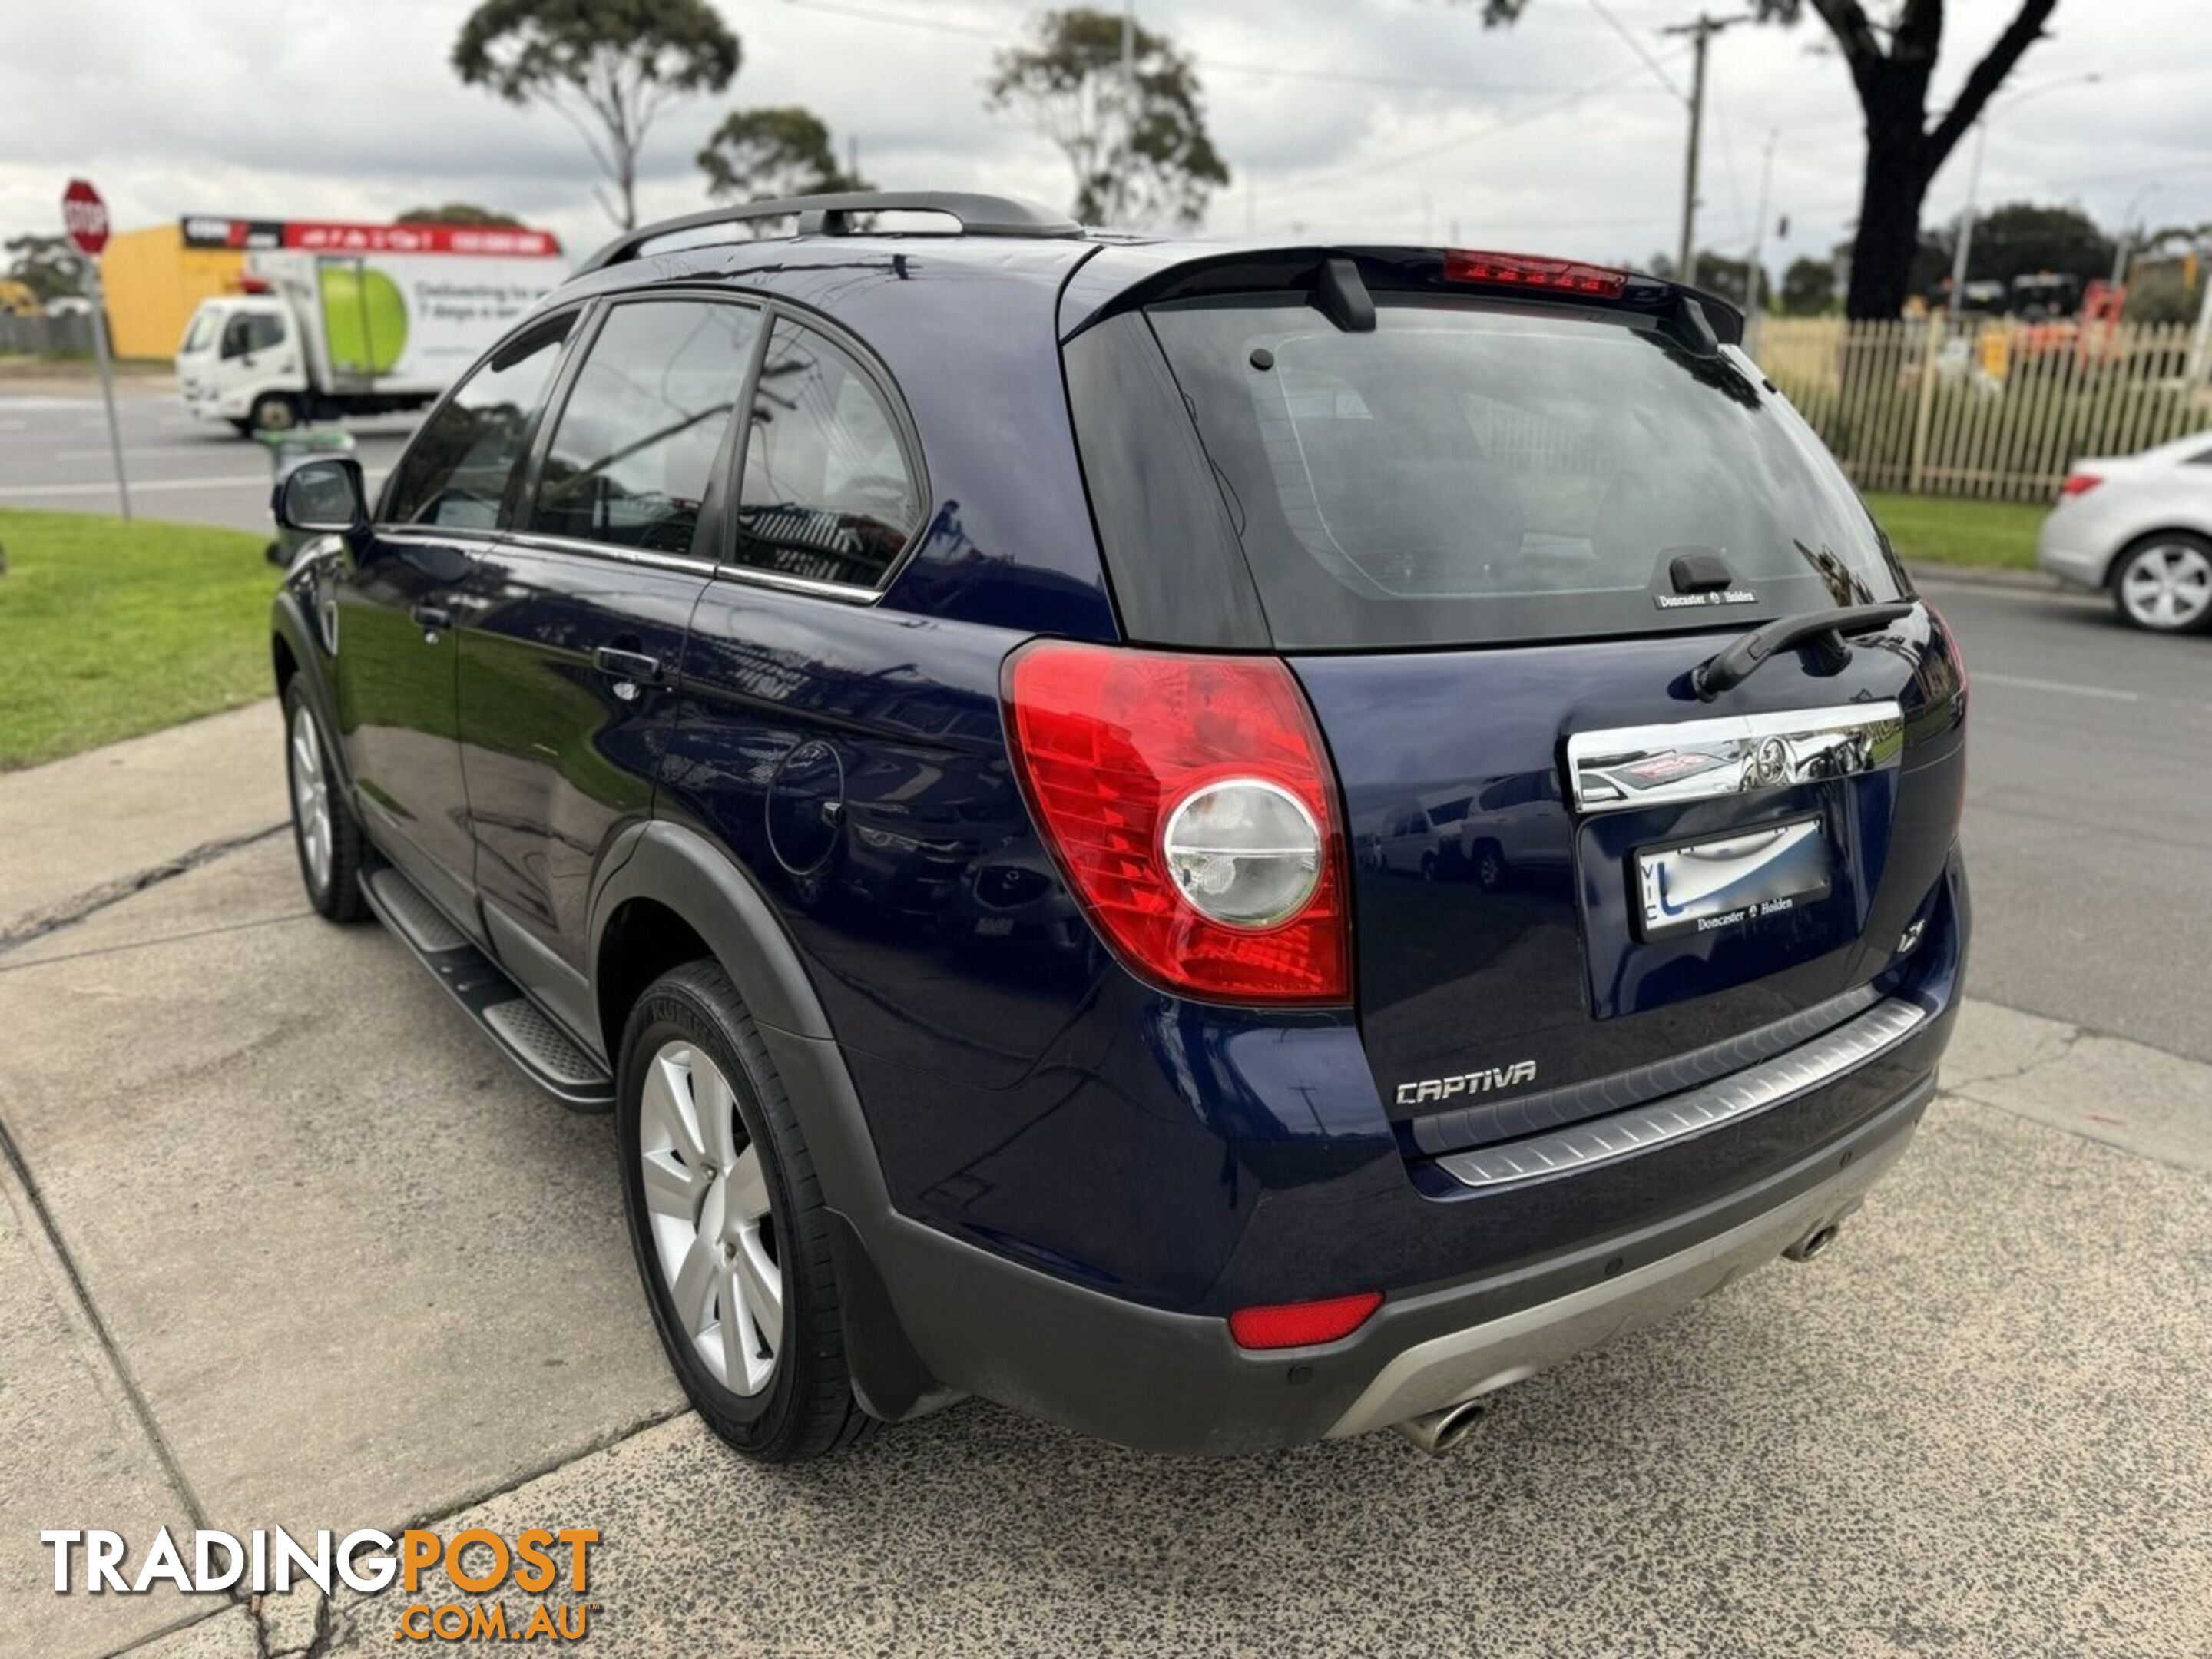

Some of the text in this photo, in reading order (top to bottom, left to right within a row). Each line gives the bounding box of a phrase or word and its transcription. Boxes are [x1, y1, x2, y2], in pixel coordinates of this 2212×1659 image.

[62, 200, 107, 233] STOP
[1659, 591, 1754, 608] Doncaster Holden
[1697, 897, 1793, 932] Doncaster Holden
[1395, 1059, 1537, 1104] CAPTIVA
